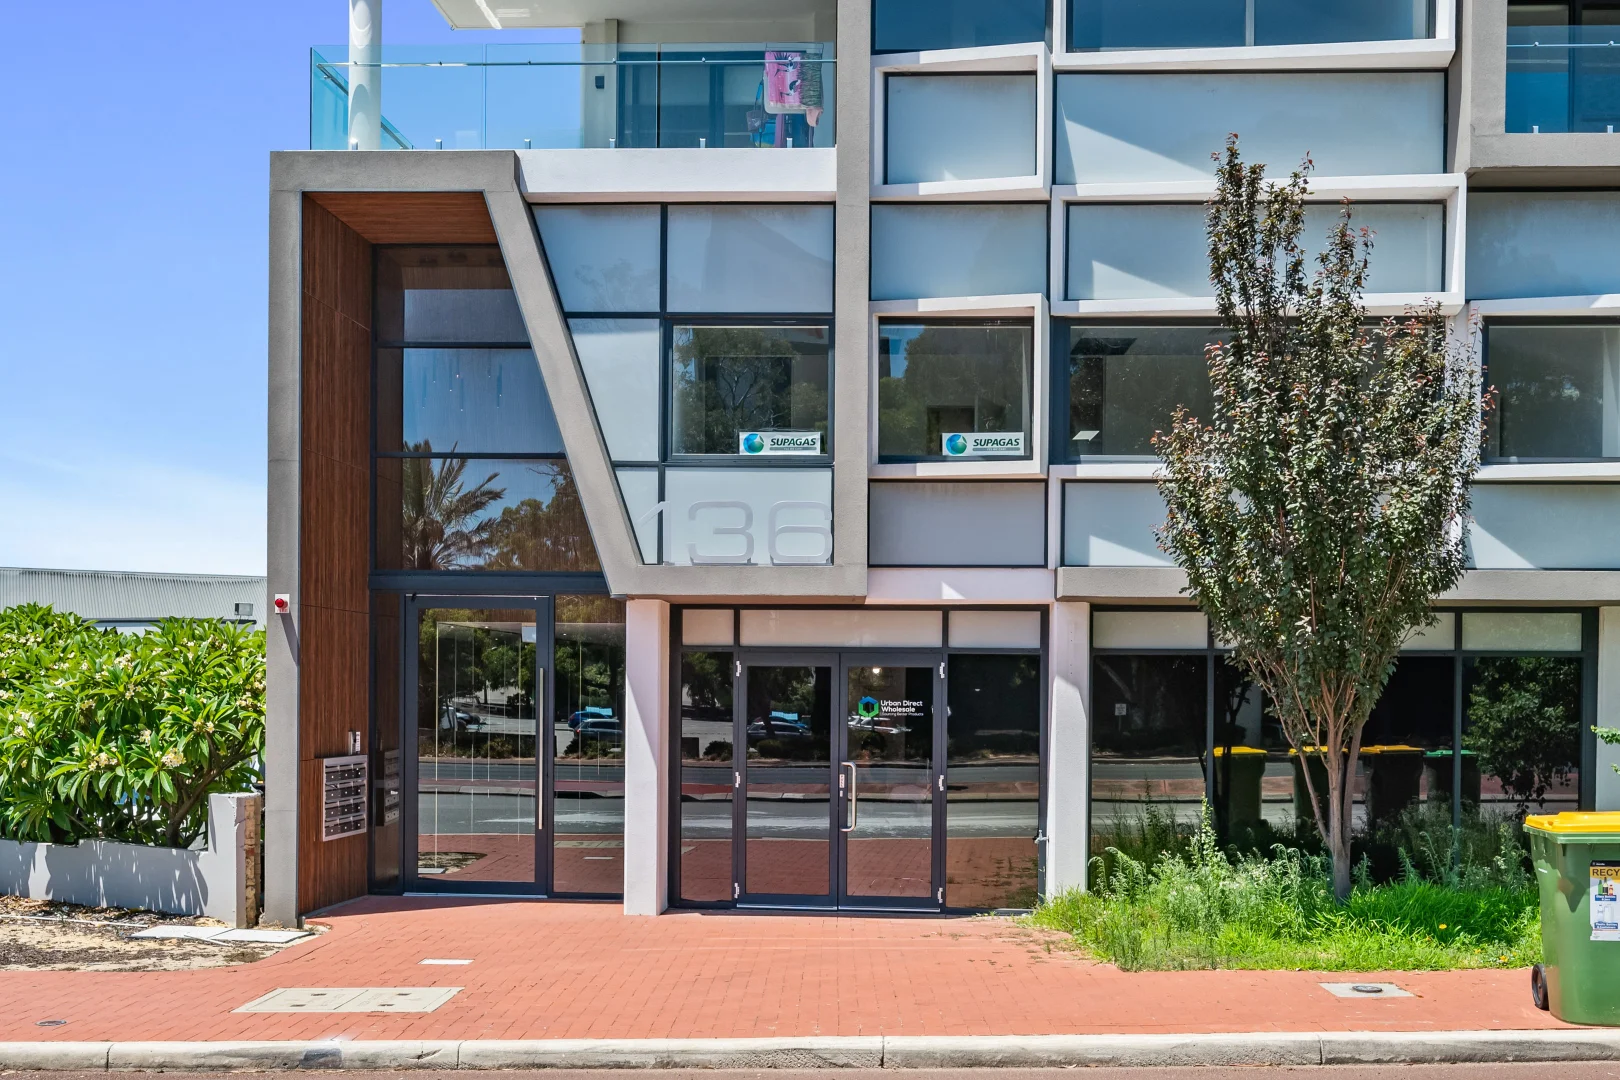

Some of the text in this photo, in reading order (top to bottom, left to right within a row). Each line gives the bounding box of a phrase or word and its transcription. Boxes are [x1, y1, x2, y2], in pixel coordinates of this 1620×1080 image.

[770, 438, 817, 446] SUPAGAS
[972, 438, 1020, 447] SUPAGAS
[636, 501, 833, 563] 136
[1592, 868, 1620, 876] RECY
